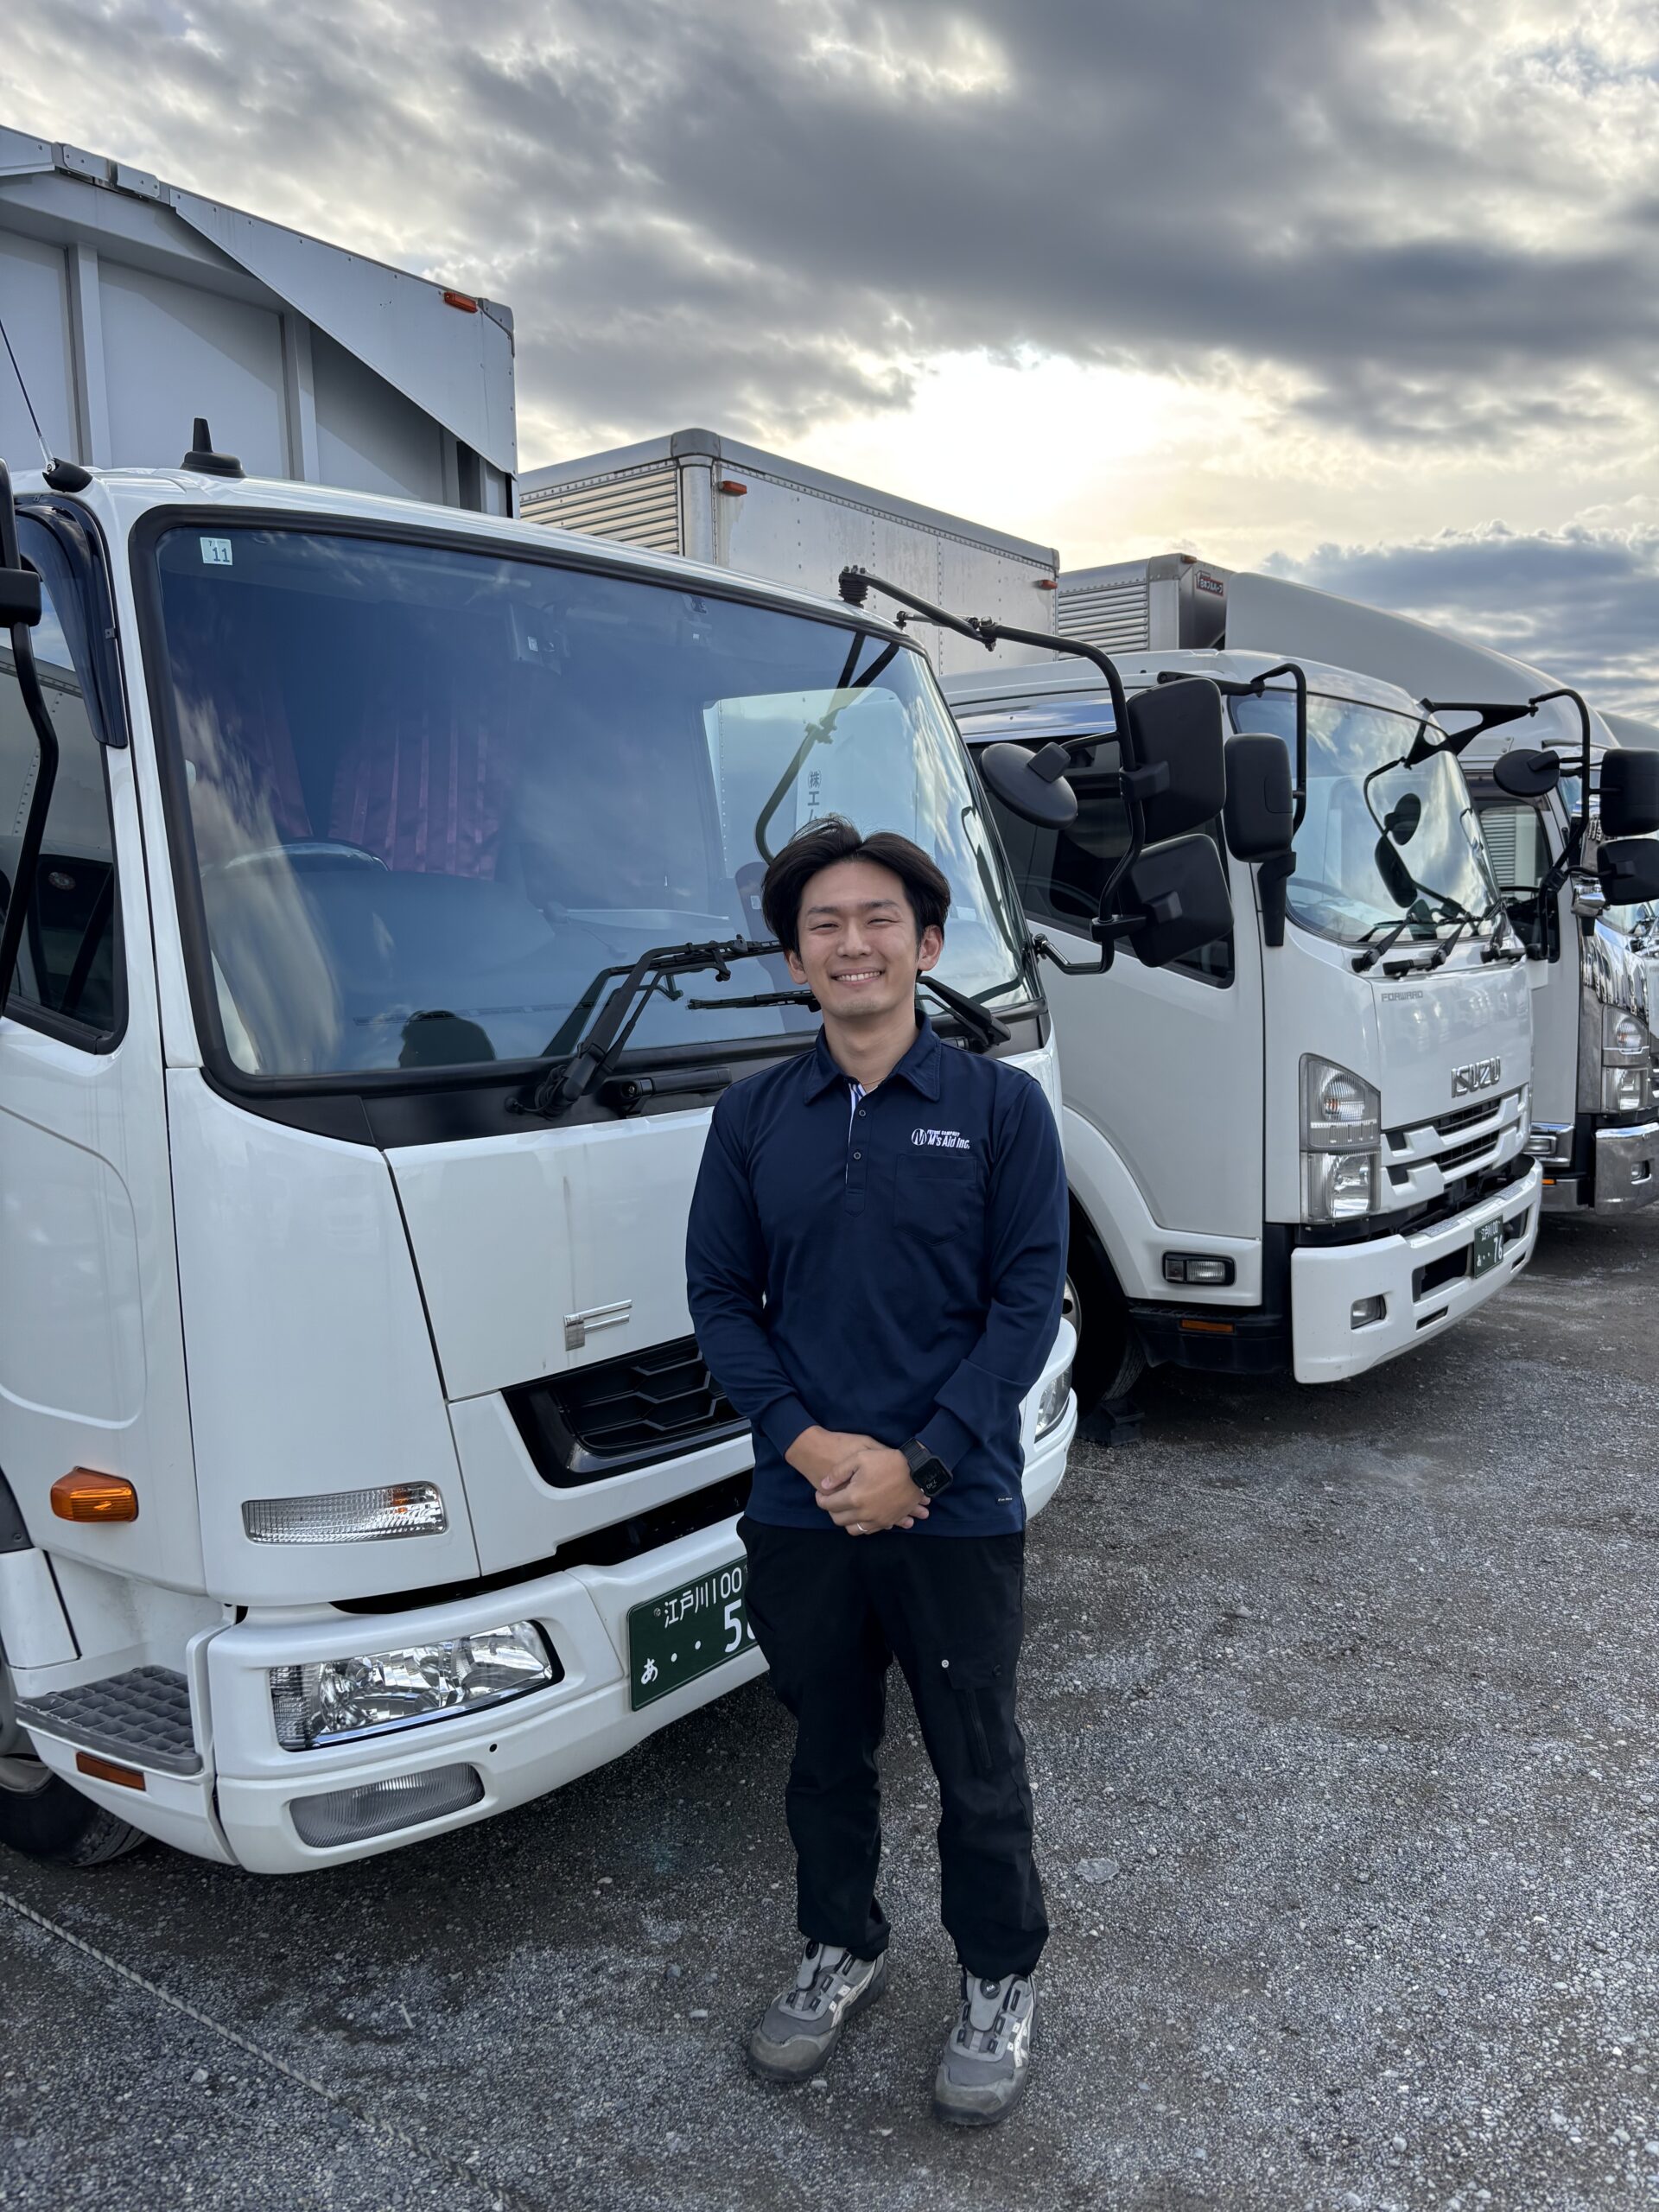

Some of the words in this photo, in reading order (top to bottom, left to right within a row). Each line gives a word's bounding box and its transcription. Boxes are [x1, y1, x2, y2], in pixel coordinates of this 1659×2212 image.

[212, 547, 230, 563] 11
[1382, 990, 1424, 1002] FORWARD
[1451, 1056, 1502, 1098] ISUZU
[927, 1134, 942, 1146] M's
[942, 1135, 957, 1147] Aid
[1493, 1234, 1503, 1263] 76
[640, 1657, 658, 1685] あ
